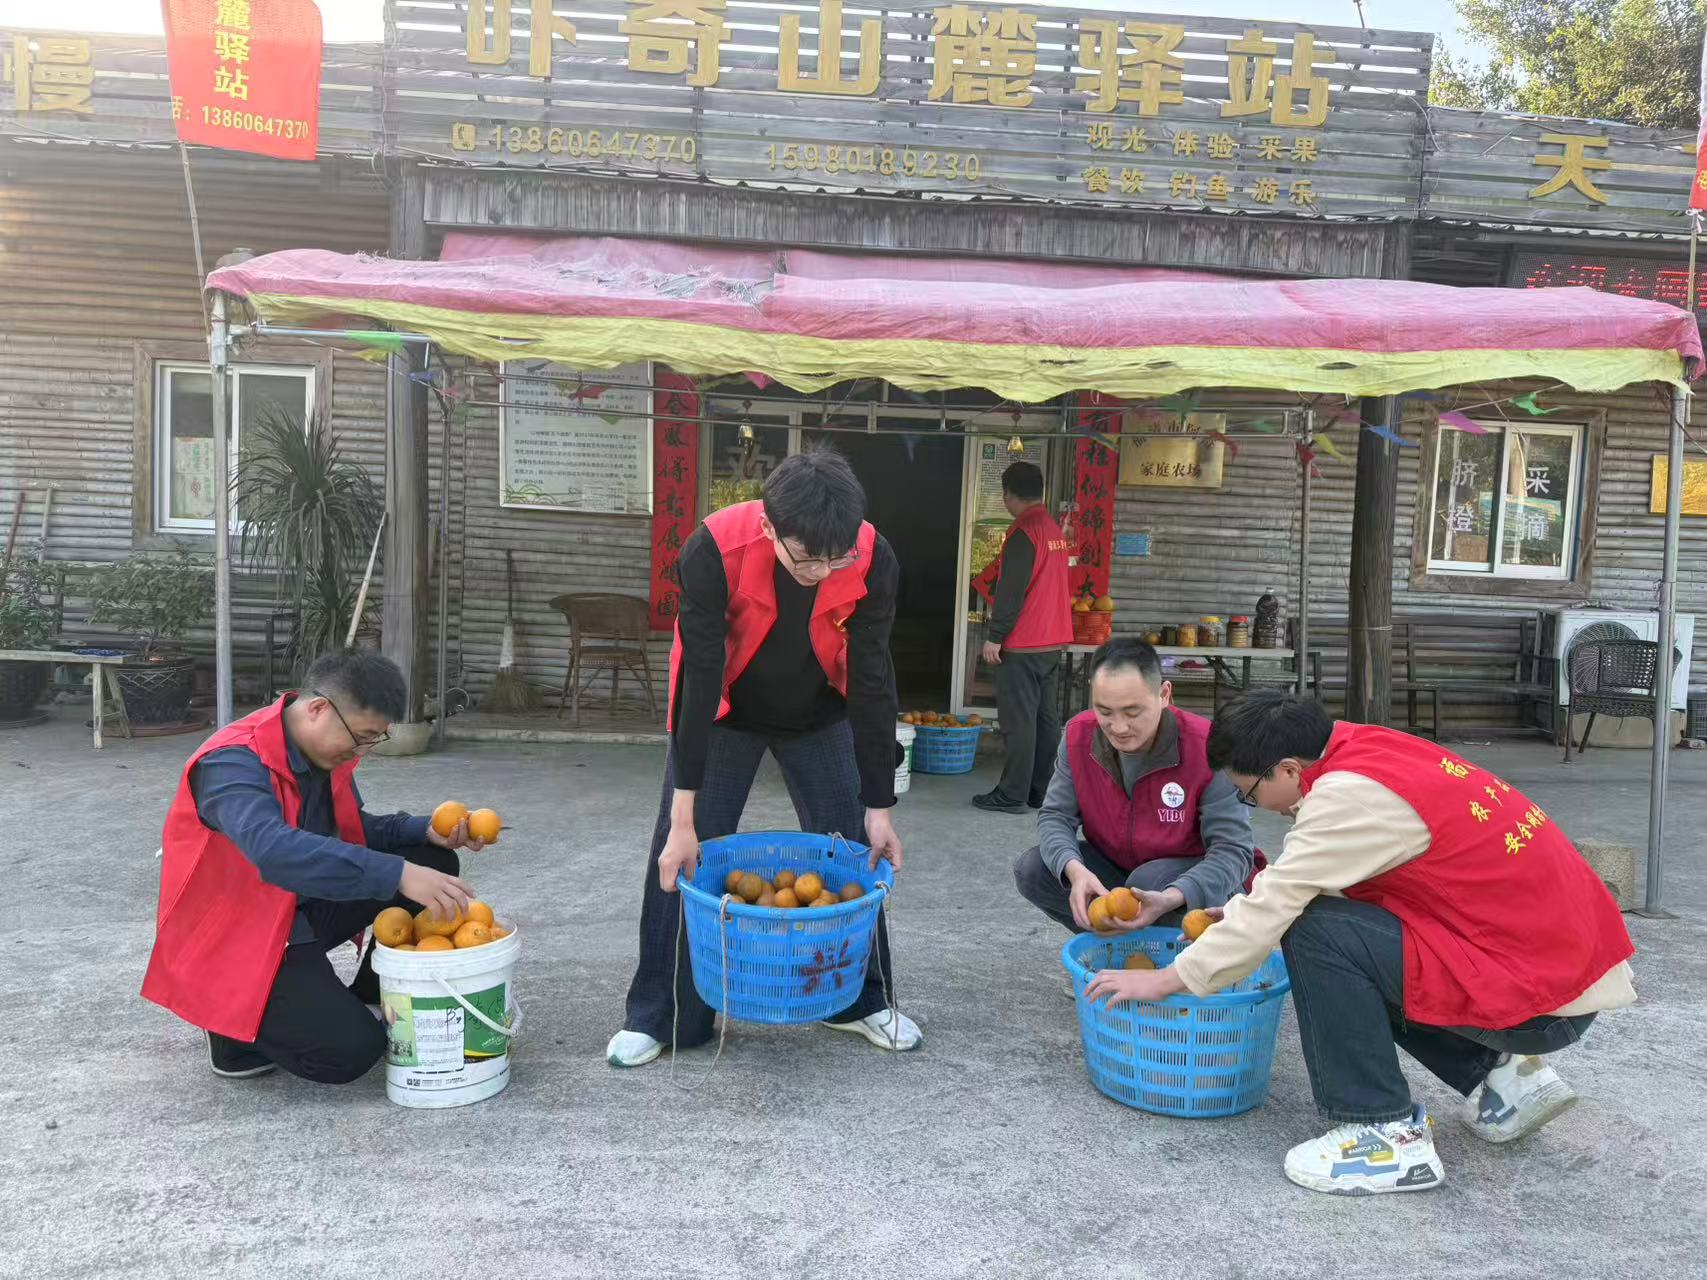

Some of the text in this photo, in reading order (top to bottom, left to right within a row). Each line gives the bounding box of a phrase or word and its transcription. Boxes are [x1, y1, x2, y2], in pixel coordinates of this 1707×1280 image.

[201, 105, 309, 139] 13860647370
[1087, 121, 1318, 163] 观光 体验 采果
[493, 124, 980, 181] 13860647370 15980189230
[1529, 133, 1611, 204] 天
[1082, 166, 1315, 205] 餐饮 钓鱼 游乐
[1141, 461, 1202, 479] 家庭农场
